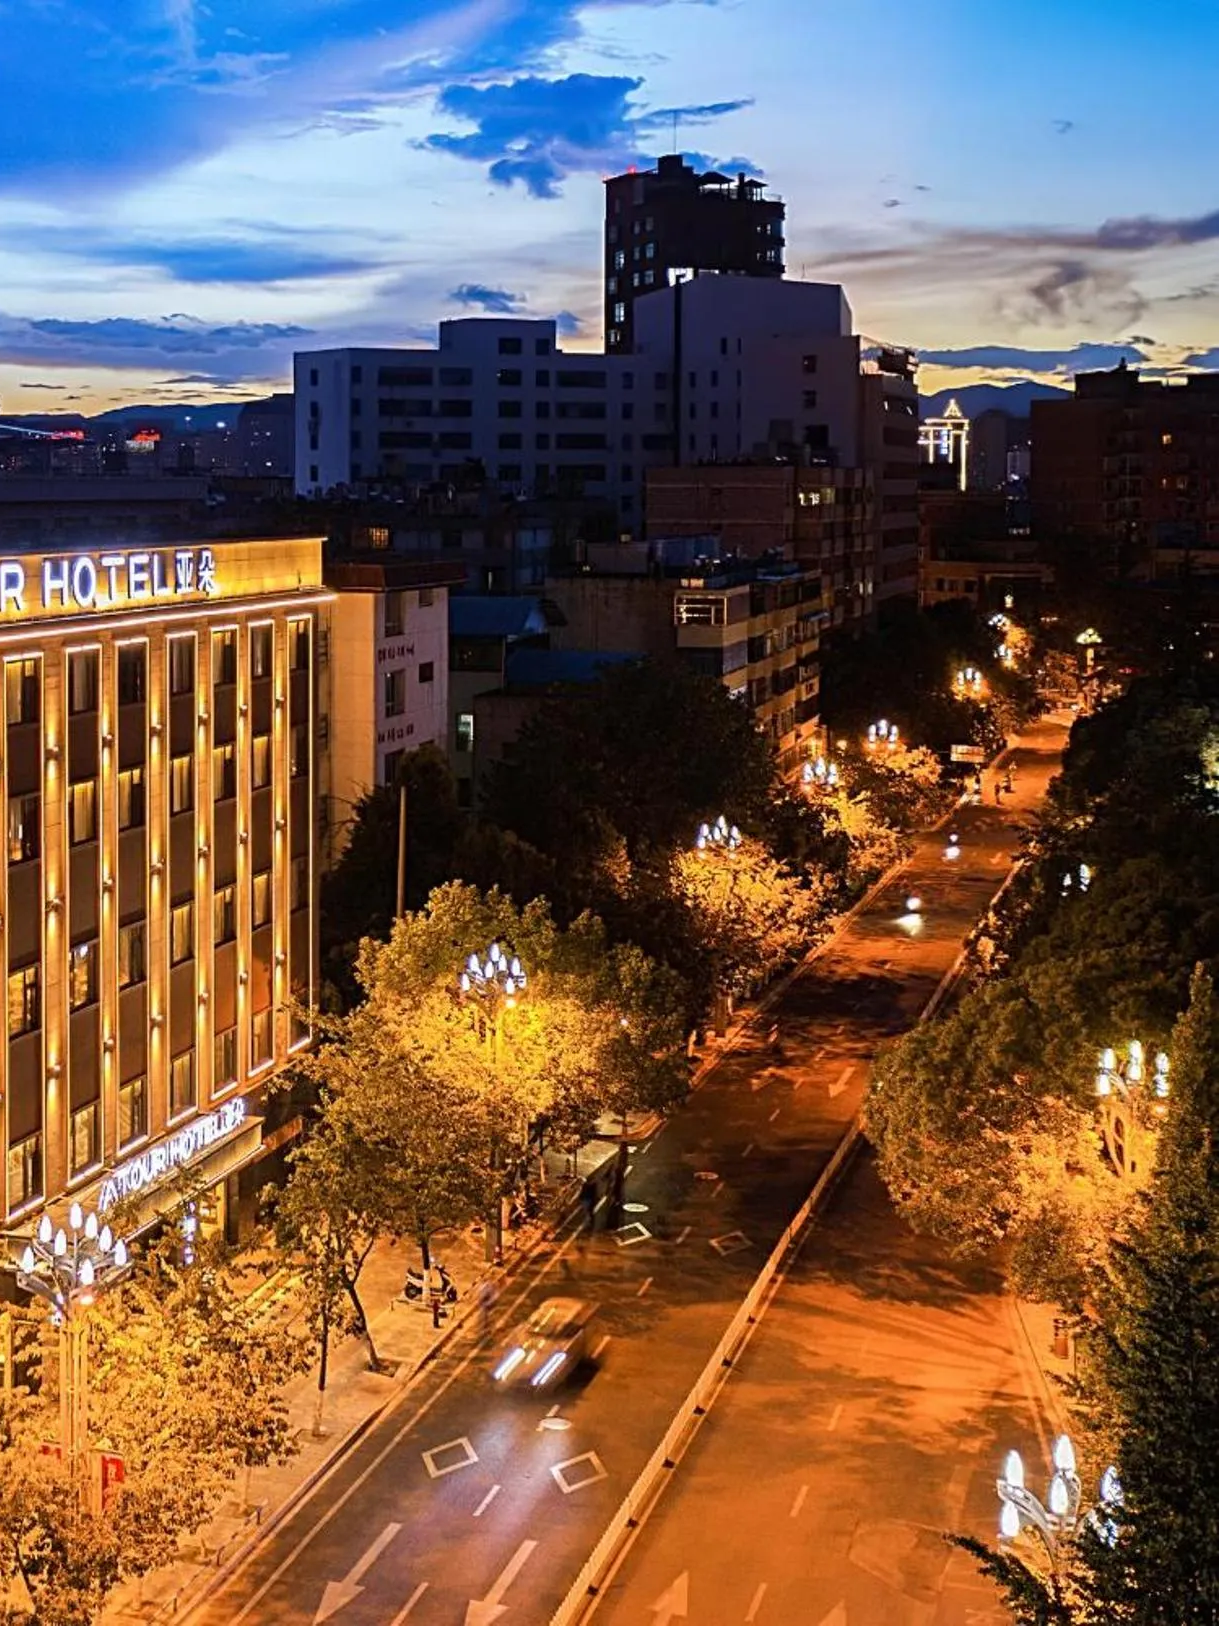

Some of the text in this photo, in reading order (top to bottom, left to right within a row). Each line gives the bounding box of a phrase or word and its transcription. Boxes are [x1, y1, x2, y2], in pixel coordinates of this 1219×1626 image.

[42, 551, 170, 608] HOTEL
[174, 546, 217, 597] 亚朵
[97, 1113, 224, 1212] ATOUR HOTEL
